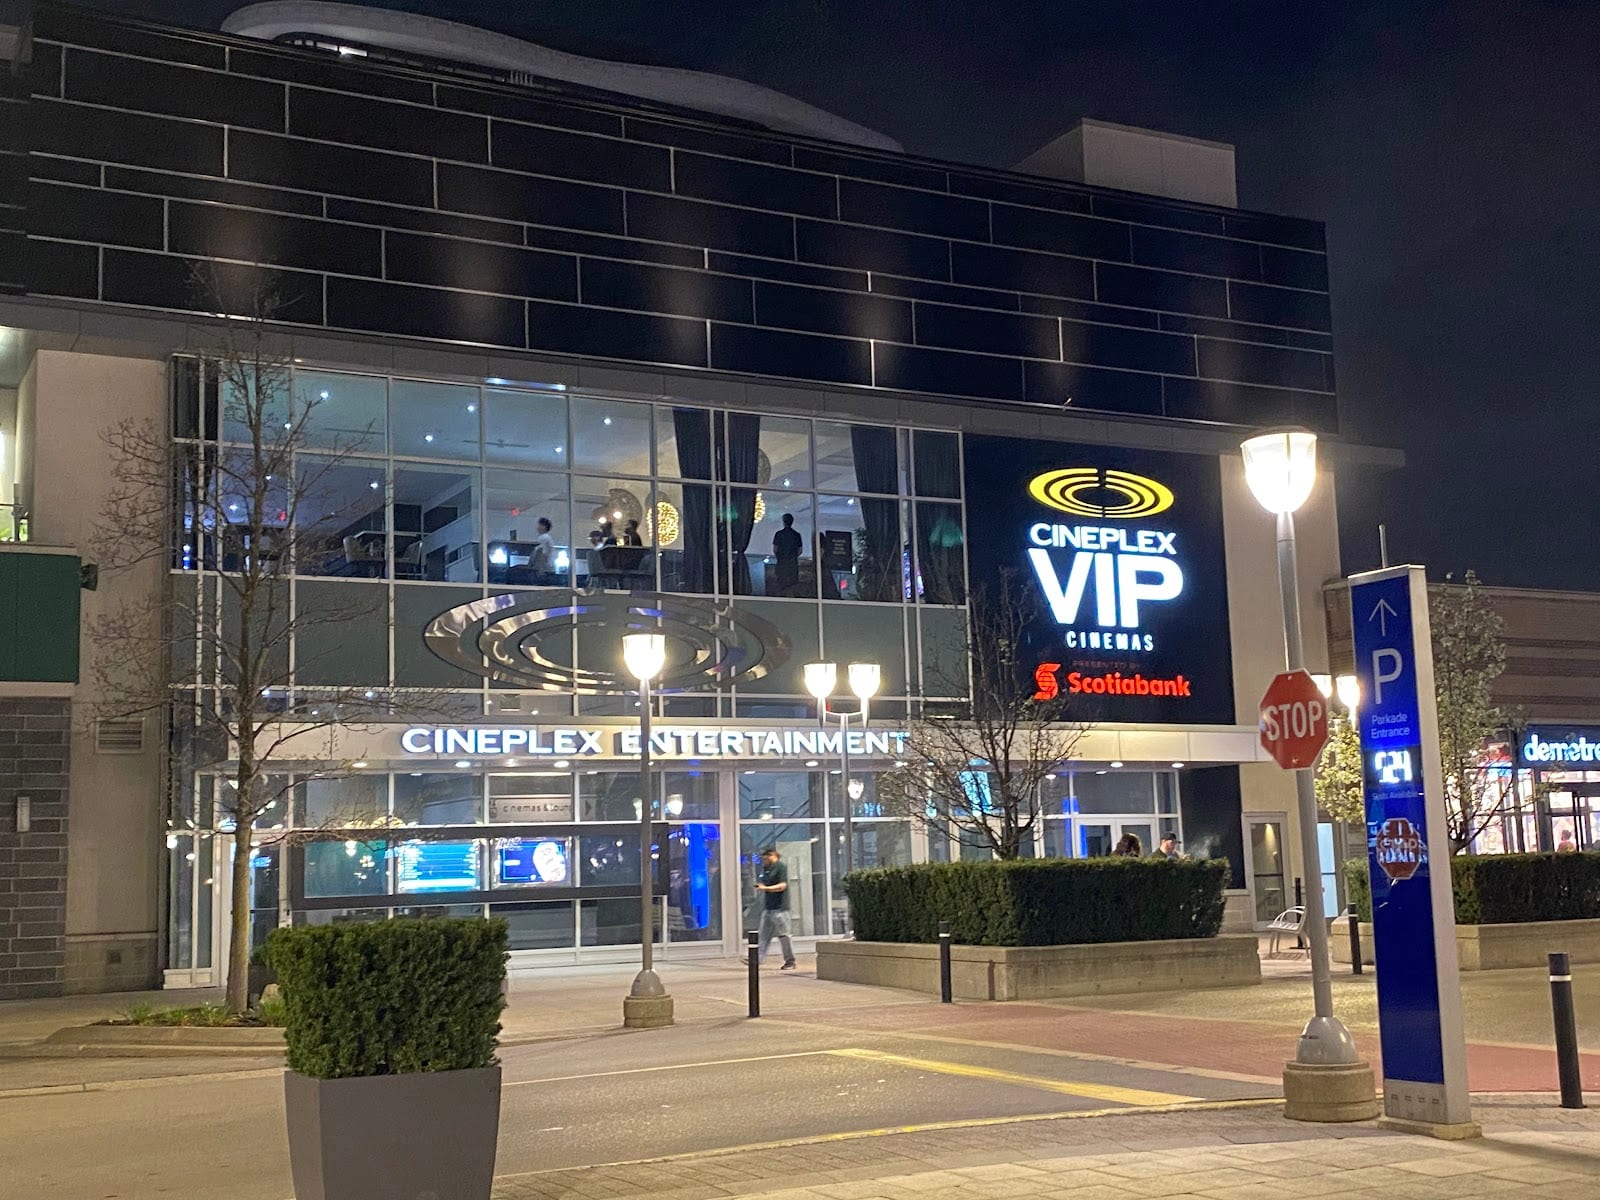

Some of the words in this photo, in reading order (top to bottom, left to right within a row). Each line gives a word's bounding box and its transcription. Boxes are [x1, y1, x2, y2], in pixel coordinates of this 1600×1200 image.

[1029, 522, 1178, 555] CINEPLEX
[1028, 548, 1184, 628] VIP
[1066, 630, 1154, 652] CINEMAS
[1067, 672, 1191, 697] Scotiabank
[1372, 648, 1403, 706] P
[1265, 701, 1323, 742] STOP
[1371, 712, 1408, 726] Parkade
[1371, 726, 1411, 740] Entrance
[402, 728, 604, 755] CINEPLEX
[621, 730, 910, 756] ENTERTAINMENT
